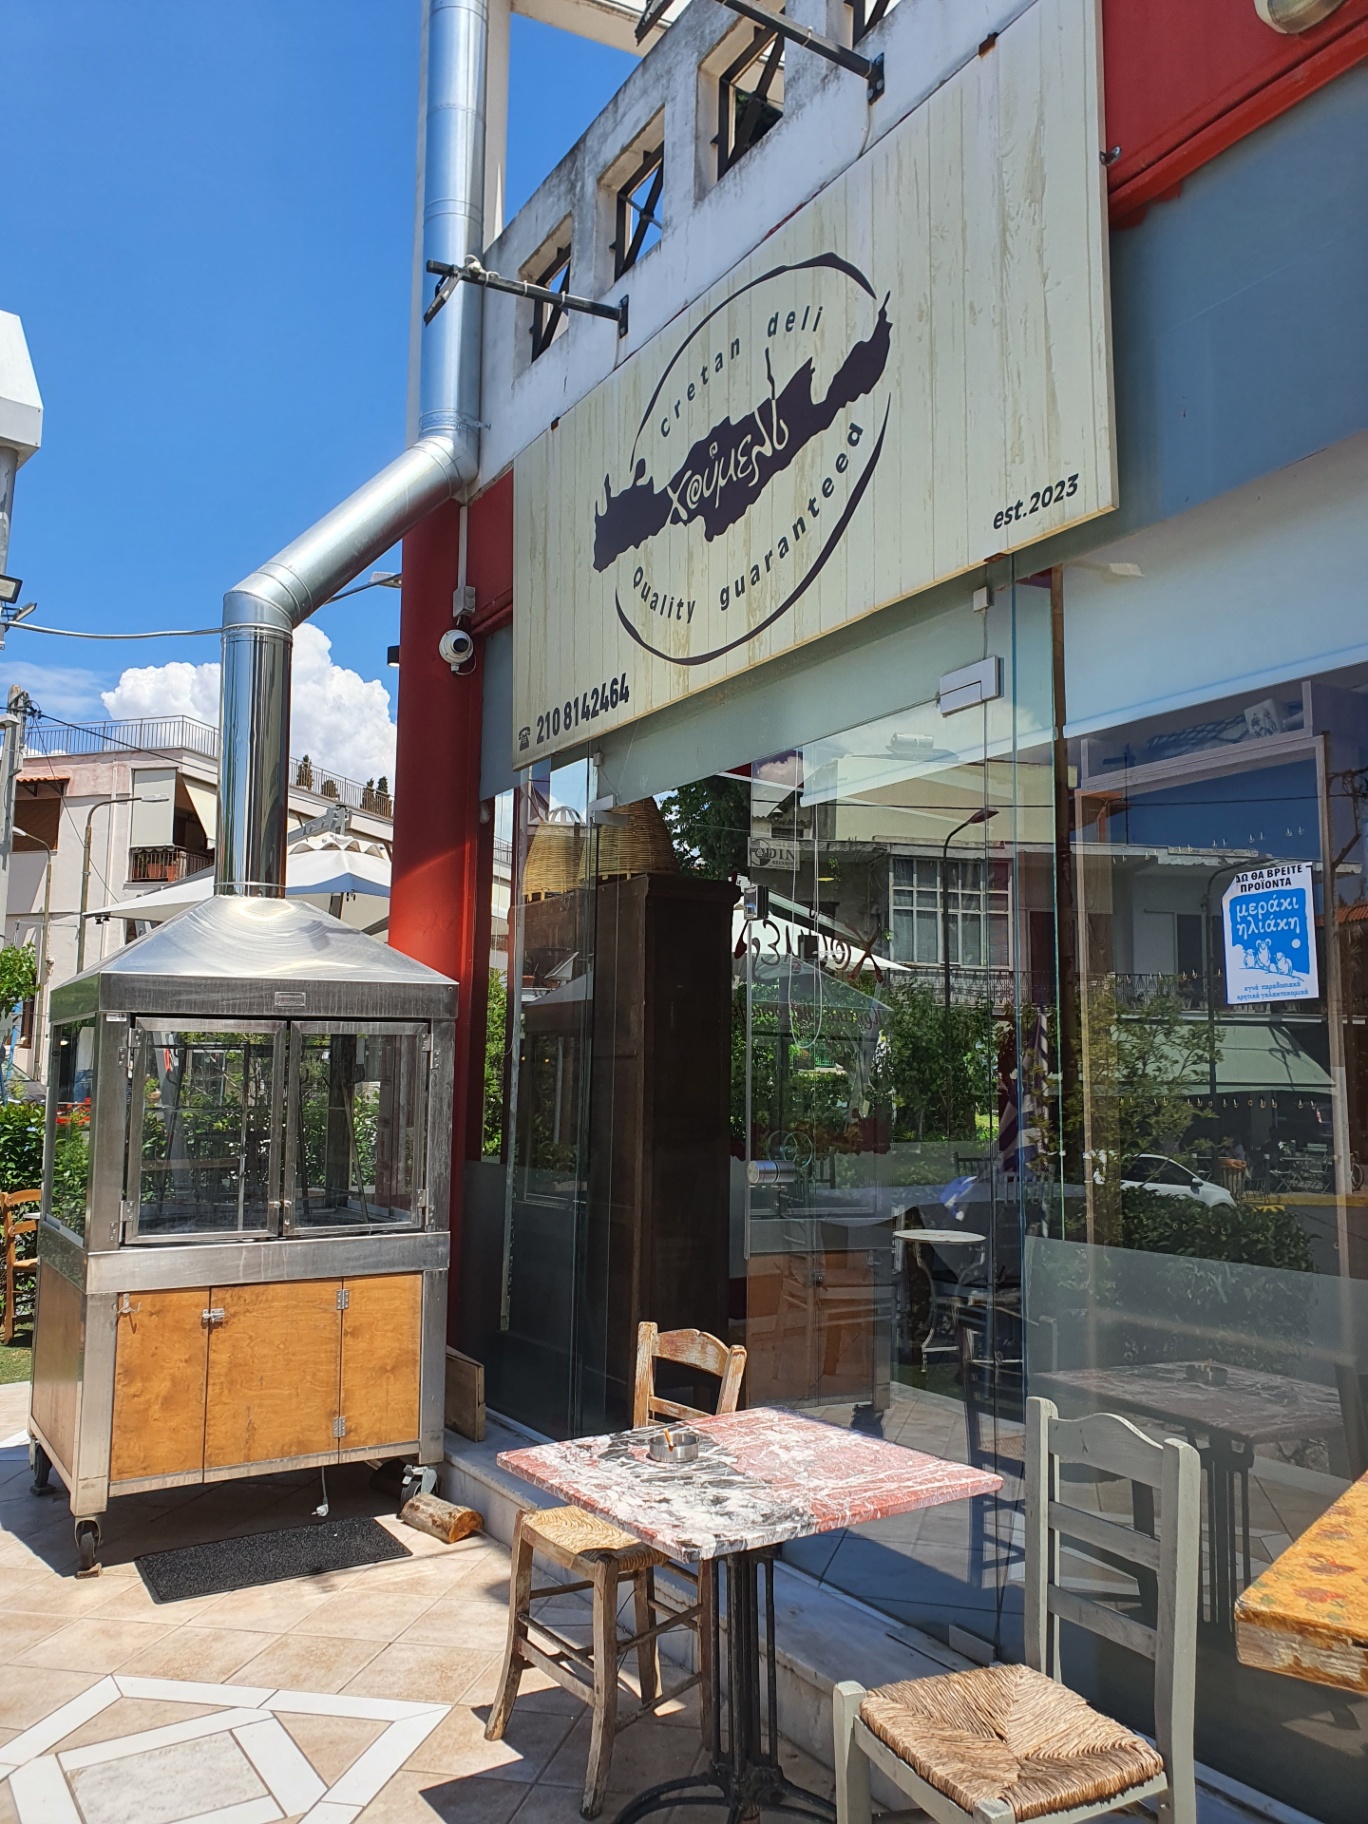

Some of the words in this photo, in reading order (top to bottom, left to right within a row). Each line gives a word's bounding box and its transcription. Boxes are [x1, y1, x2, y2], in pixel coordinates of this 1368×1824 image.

[660, 336, 741, 438] cretan
[766, 305, 824, 338] deli
[993, 473, 1079, 529] est.2023
[633, 566, 696, 624] Quality
[719, 422, 864, 611] guaranteed
[1235, 873, 1249, 884] ΔΩ
[1251, 870, 1264, 880] ΘΑ
[1267, 864, 1303, 878] ΒΡΕΙΤΕ
[1240, 877, 1292, 893] ΠΡΟΪΟΝΤΑ
[1236, 894, 1299, 922] μεράκι
